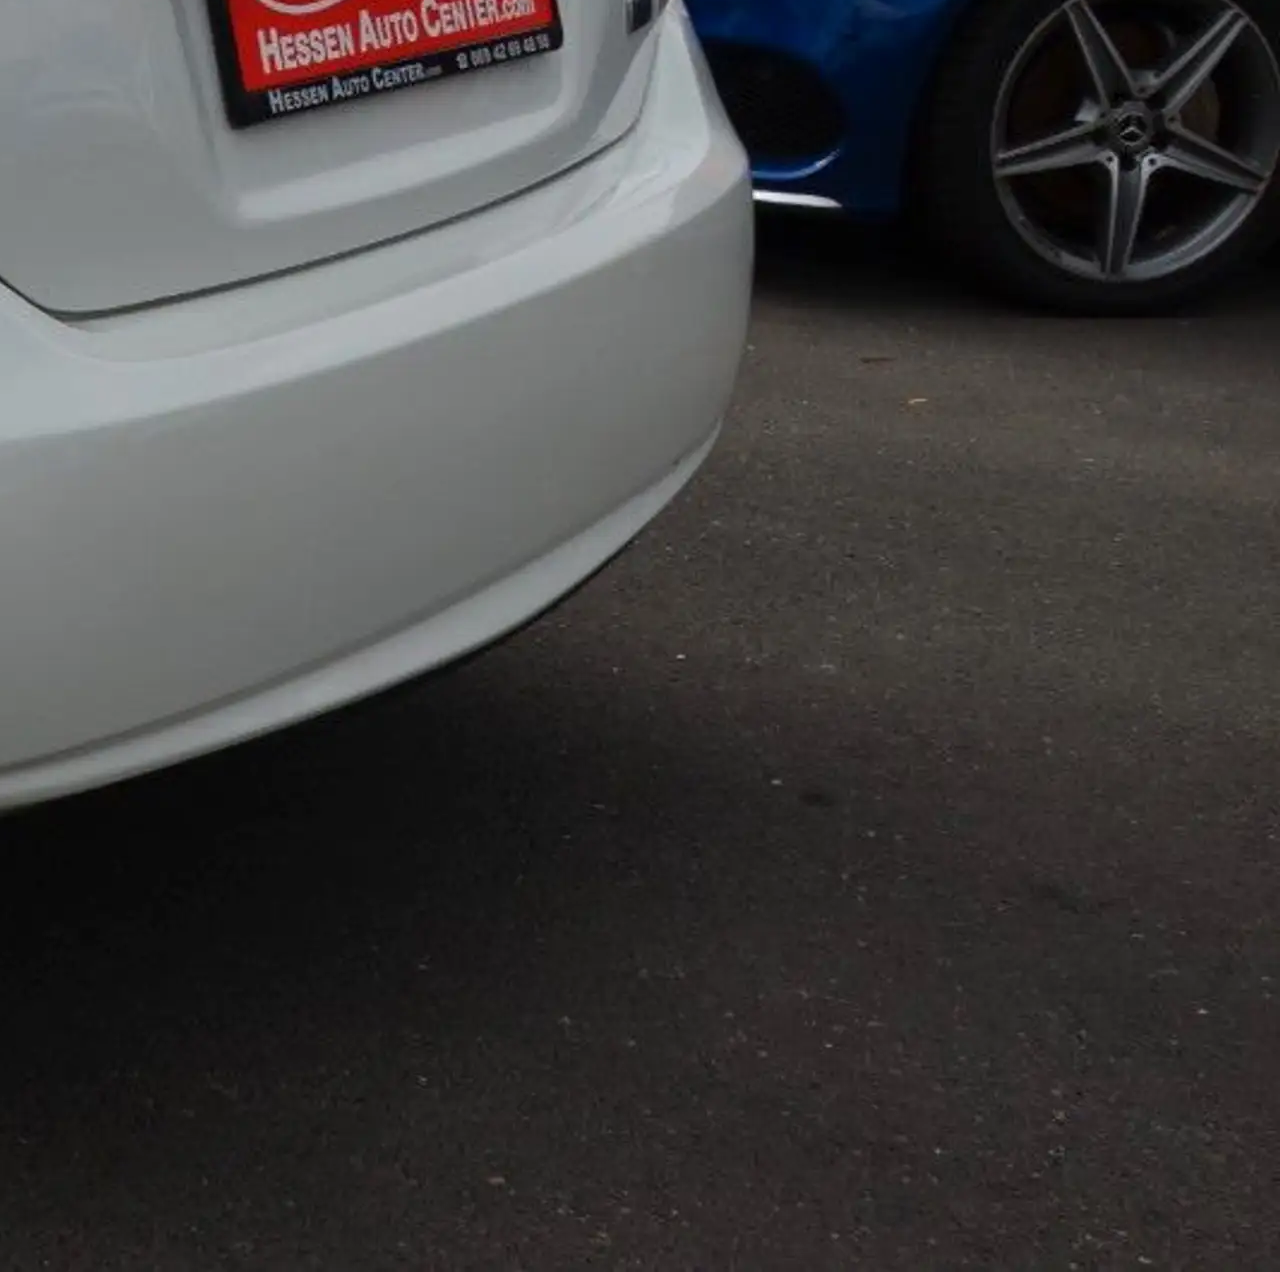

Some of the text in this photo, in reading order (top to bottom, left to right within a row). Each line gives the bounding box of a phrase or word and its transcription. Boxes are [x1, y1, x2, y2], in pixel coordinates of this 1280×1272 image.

[256, 22, 355, 74] HESSEN
[358, 8, 420, 52] AUTO
[331, 75, 370, 101] AUTO
